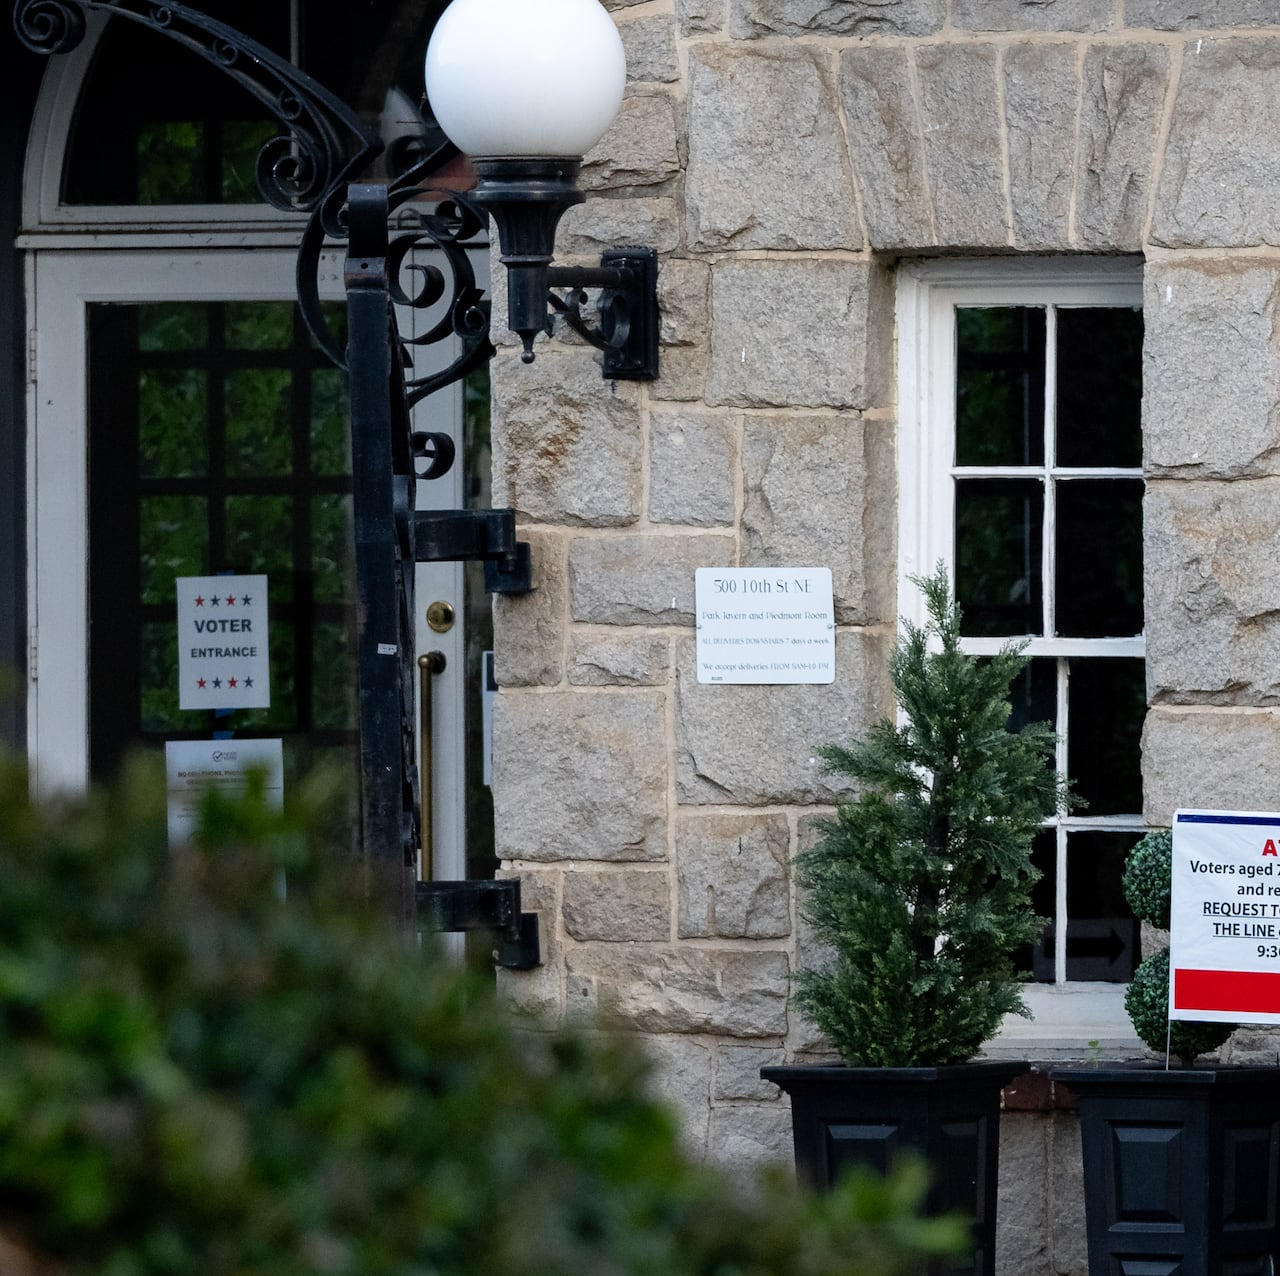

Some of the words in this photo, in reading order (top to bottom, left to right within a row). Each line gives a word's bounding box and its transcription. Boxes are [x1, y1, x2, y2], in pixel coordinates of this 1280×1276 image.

[743, 579, 771, 593] 10th
[775, 579, 789, 593] St
[194, 619, 253, 633] VOTER
[190, 647, 257, 658] ENTRANCE
[1190, 860, 1235, 874] Voters
[1238, 863, 1273, 878] aged
[1237, 883, 1264, 896] and
[1203, 902, 1268, 917] REQUEST
[1212, 922, 1241, 936] THE
[1244, 924, 1275, 937] LINE
